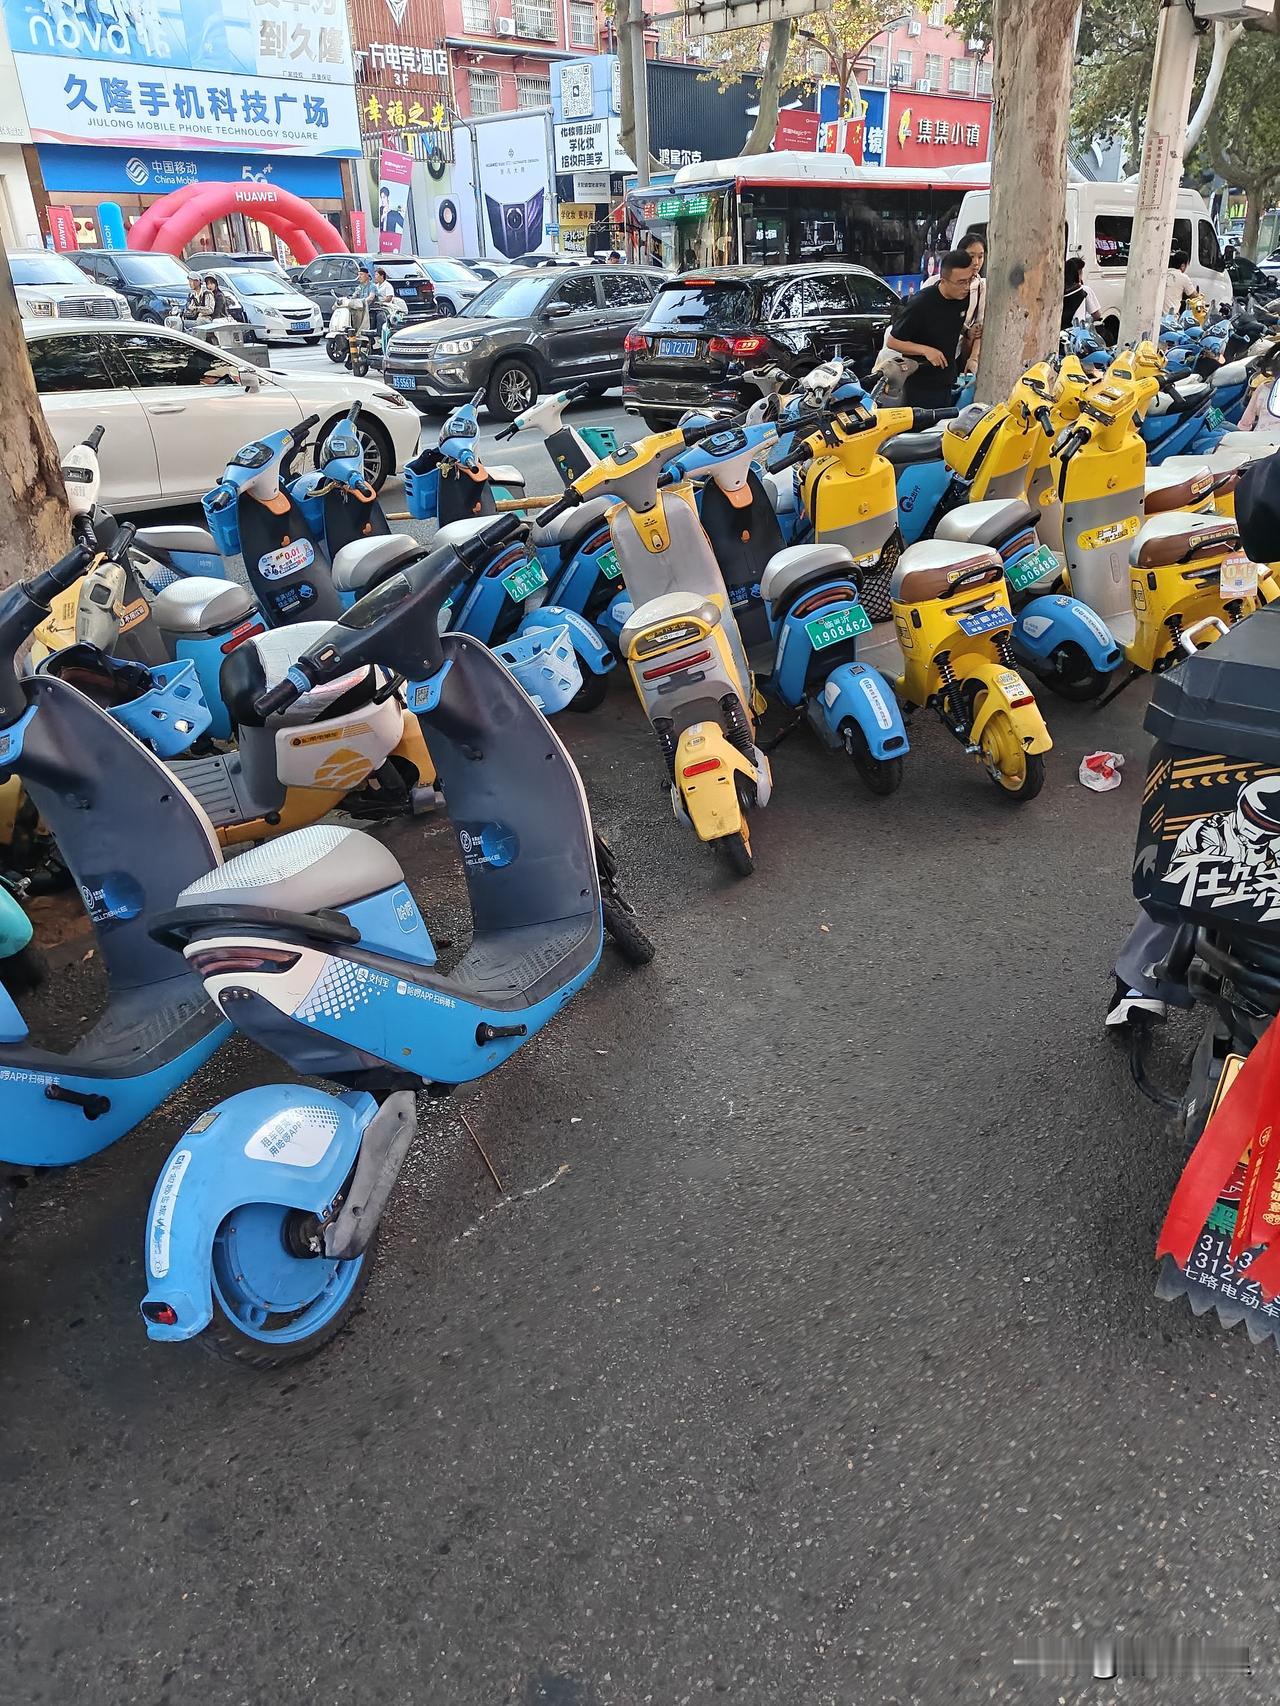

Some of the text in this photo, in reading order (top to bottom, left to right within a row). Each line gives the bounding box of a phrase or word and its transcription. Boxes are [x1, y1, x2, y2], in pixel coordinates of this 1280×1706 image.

[29, 15, 131, 56] nova
[259, 20, 345, 64] 到久隆
[394, 73, 409, 86] 3F
[64, 73, 330, 128] 久隆手机科技广场
[364, 94, 450, 131] 幸福之光
[88, 117, 319, 140] JIULONG MOBILE PHONE TECHNOLOGY SQUARE
[917, 119, 980, 147] 集集小镇
[382, 131, 438, 155] KTV
[569, 137, 595, 152] 学化妆
[151, 160, 198, 175] 中国移动
[659, 148, 702, 165] 鸿星尔克
[154, 175, 175, 184] China
[235, 191, 278, 202] HUAWEI
[57, 217, 67, 249] HUAWEI
[1015, 556, 1056, 587] 1906486
[815, 618, 868, 645] 1908462
[396, 901, 413, 920] 哈啰
[368, 973, 390, 988] 支付宝
